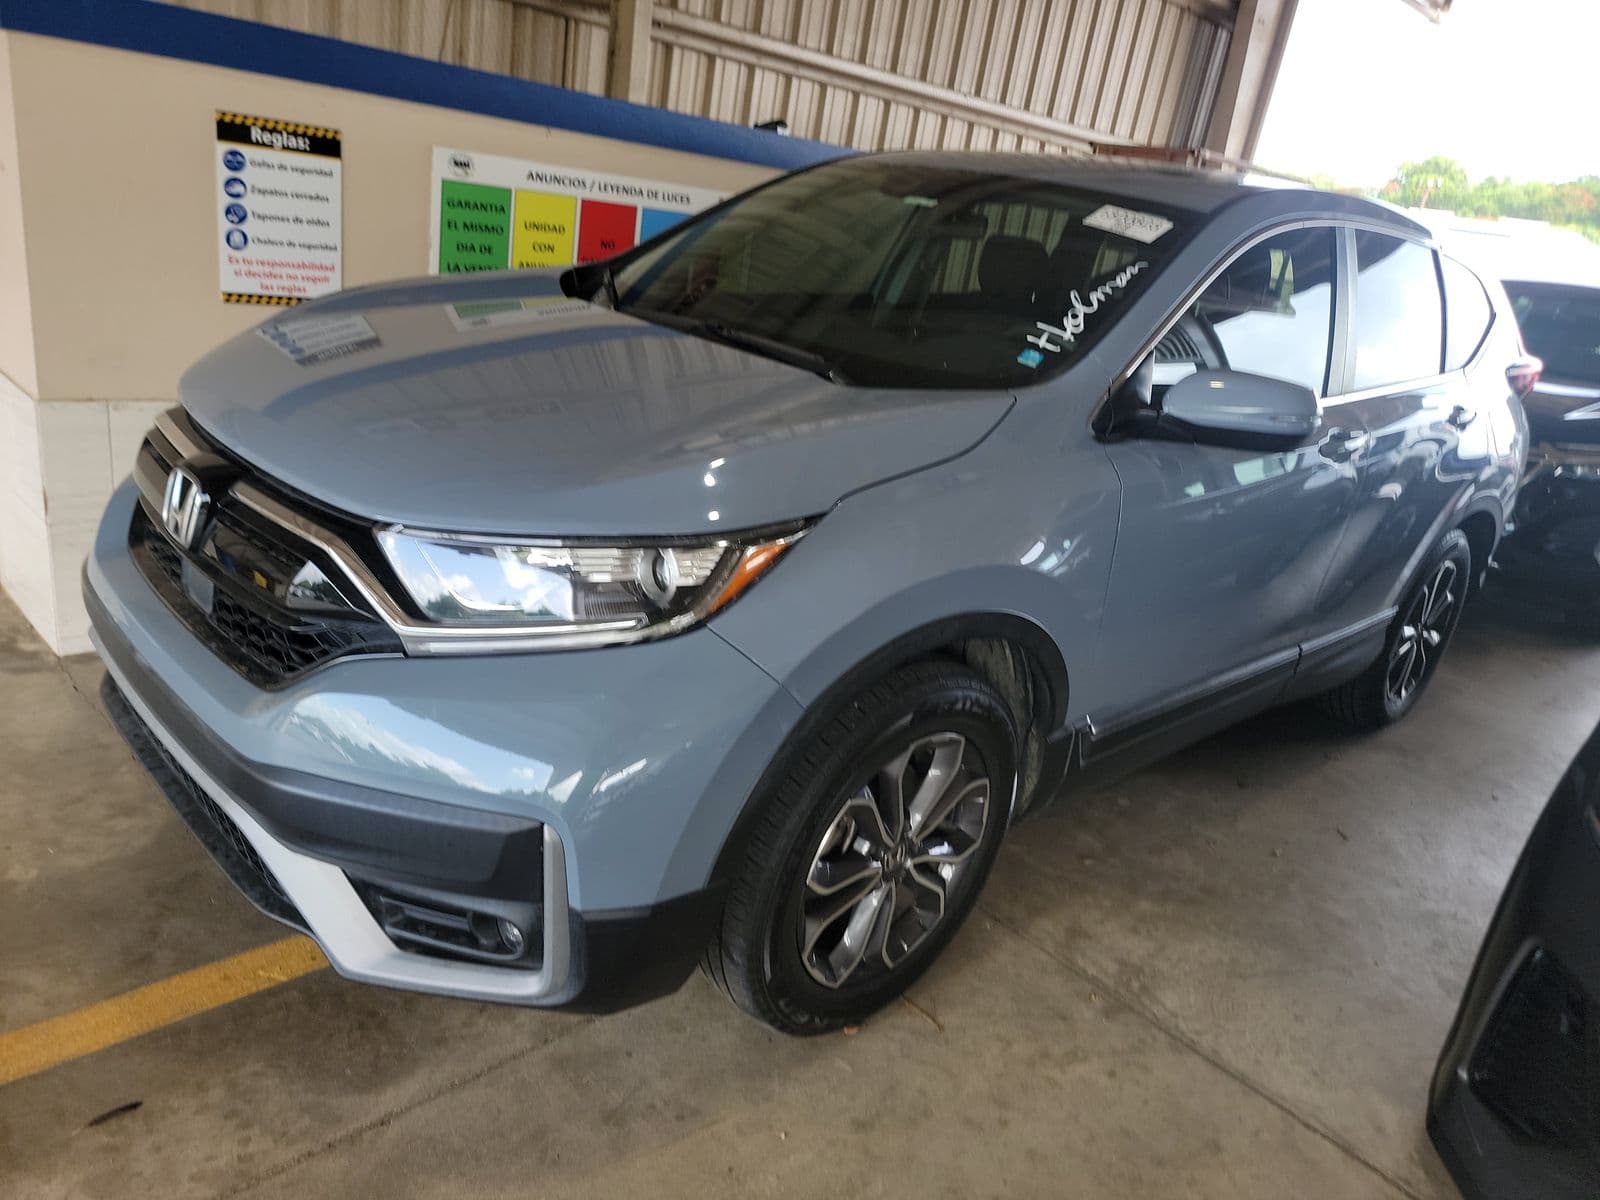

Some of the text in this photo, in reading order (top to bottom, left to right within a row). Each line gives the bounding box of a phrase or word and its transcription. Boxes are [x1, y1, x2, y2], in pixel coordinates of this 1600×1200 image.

[250, 125, 310, 151] Reglas:
[527, 169, 587, 189] ANUNCIOS
[598, 183, 644, 199] LEYENDA
[647, 188, 659, 199] DE
[662, 190, 691, 206] LUCES
[447, 199, 506, 215] GARANTIA
[447, 219, 504, 236] EL MISMO
[523, 221, 566, 235] UNIDAD
[456, 241, 493, 256] DIA DE
[532, 241, 555, 254] CON
[600, 240, 616, 250] NO
